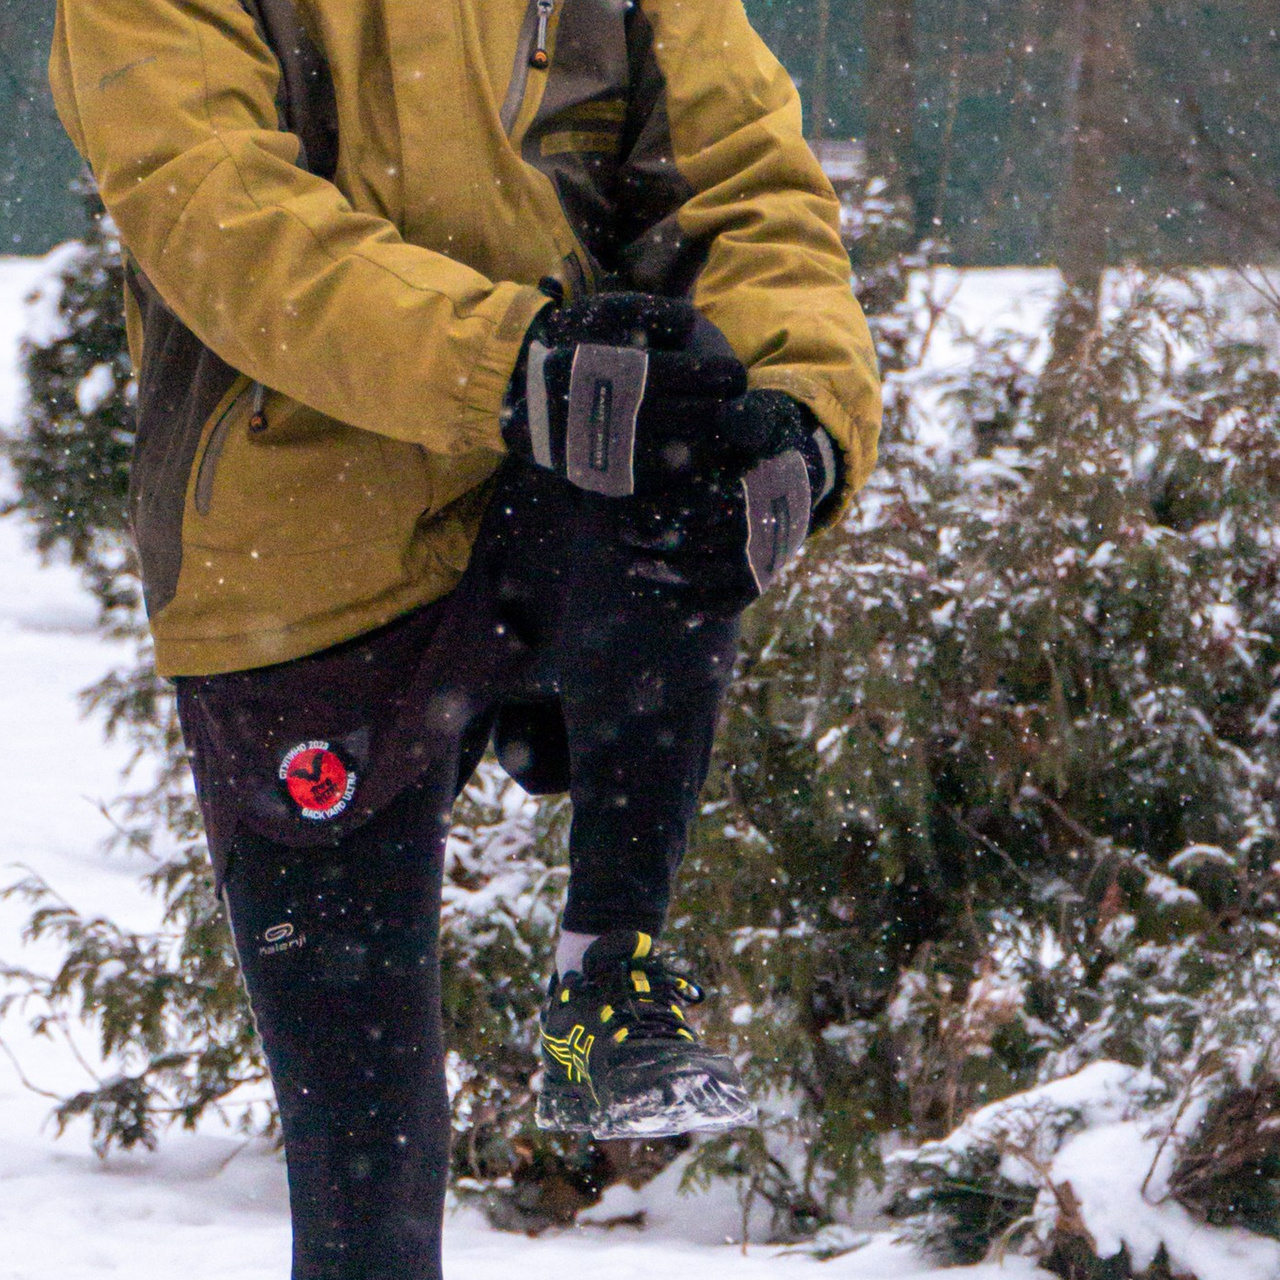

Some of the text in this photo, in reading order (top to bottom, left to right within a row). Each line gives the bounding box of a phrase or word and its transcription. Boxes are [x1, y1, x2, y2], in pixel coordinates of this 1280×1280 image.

[279, 740, 329, 779] СТУПИНО 2023
[302, 772, 357, 820] BACKYARD ULTRA
